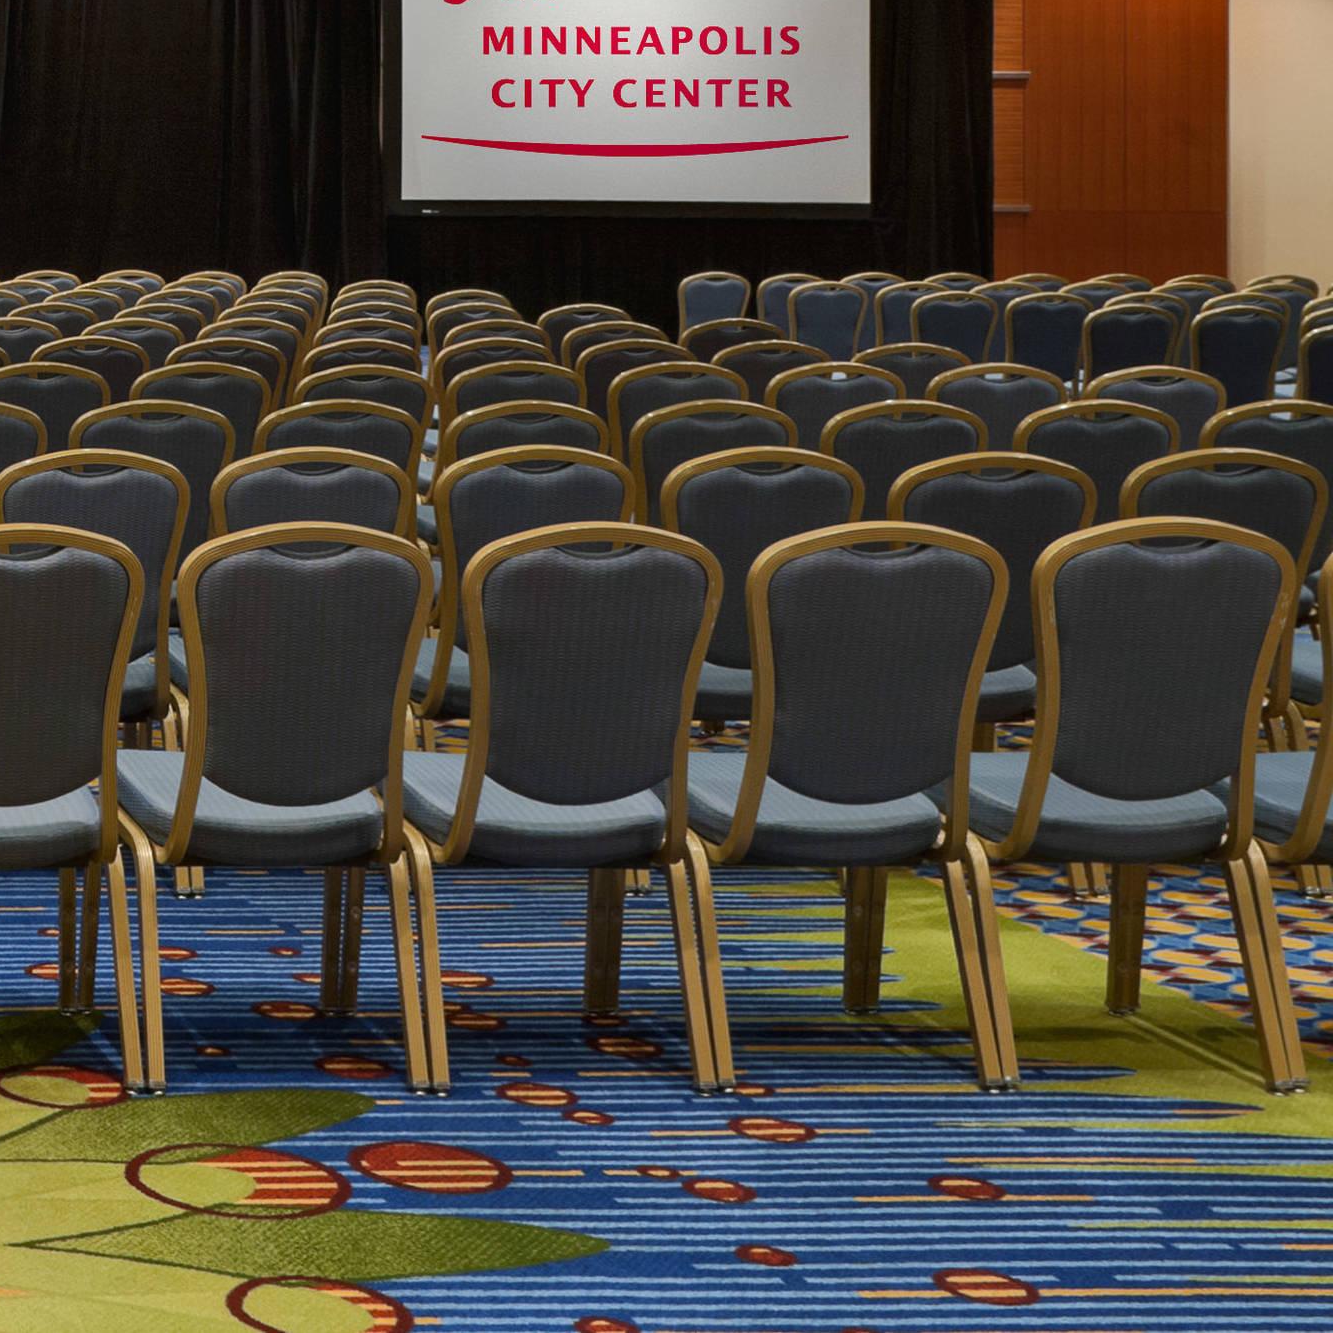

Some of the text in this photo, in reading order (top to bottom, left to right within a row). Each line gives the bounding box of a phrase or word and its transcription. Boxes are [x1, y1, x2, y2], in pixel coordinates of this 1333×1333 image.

[482, 25, 801, 57] MINNEAPOLIS
[490, 77, 792, 109] CITY CENTER
